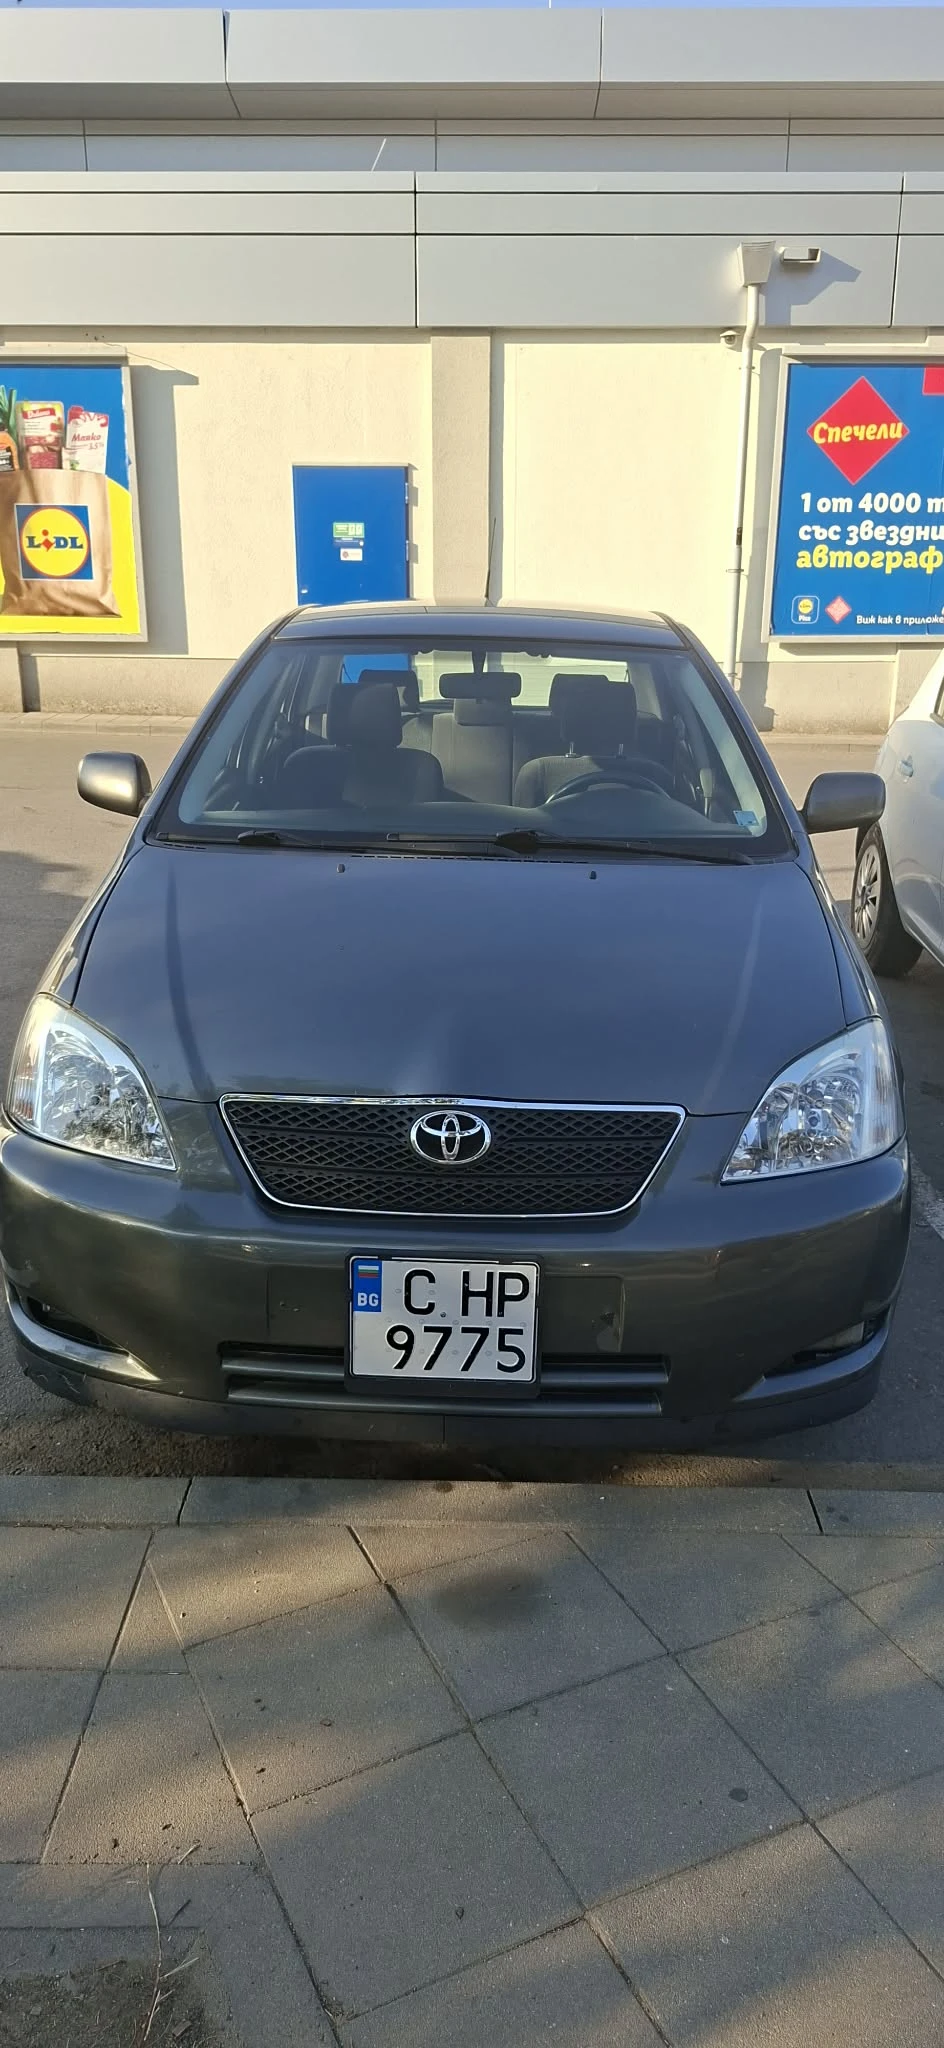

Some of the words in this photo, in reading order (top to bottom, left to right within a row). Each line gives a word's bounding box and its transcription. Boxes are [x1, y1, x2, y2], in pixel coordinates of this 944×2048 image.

[813, 422, 903, 444] Спечели
[801, 492, 811, 513] 1
[816, 497, 853, 513] от
[858, 492, 922, 513] 4000
[798, 524, 841, 541] със
[845, 519, 944, 546] звездни
[796, 544, 943, 575] автограф
[856, 614, 876, 625] Виж
[877, 615, 894, 625] как
[895, 615, 901, 625] в
[357, 1293, 379, 1307] BG
[404, 1269, 436, 1316] C
[461, 1270, 530, 1318] HP
[386, 1324, 526, 1374] 9775
